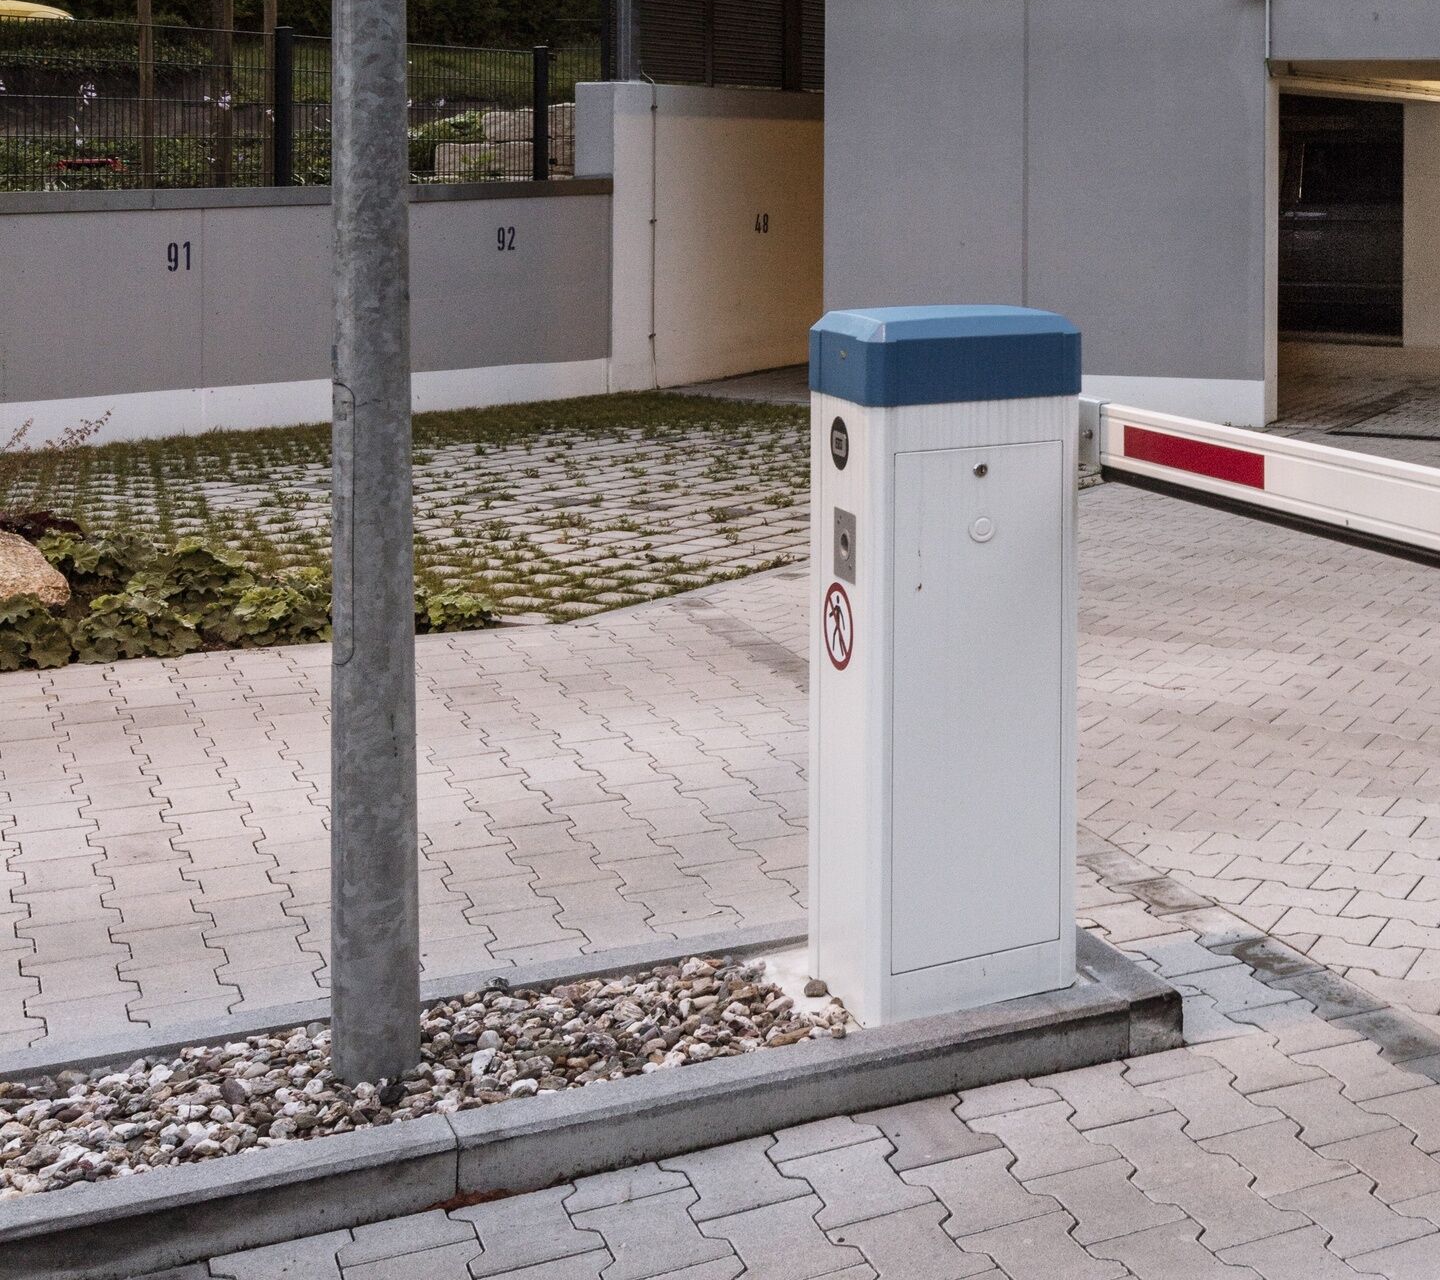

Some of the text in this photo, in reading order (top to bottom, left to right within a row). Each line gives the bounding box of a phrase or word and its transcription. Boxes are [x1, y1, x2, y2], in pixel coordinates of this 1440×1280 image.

[755, 213, 769, 234] 48
[497, 226, 516, 251] 92
[167, 241, 191, 272] 91
